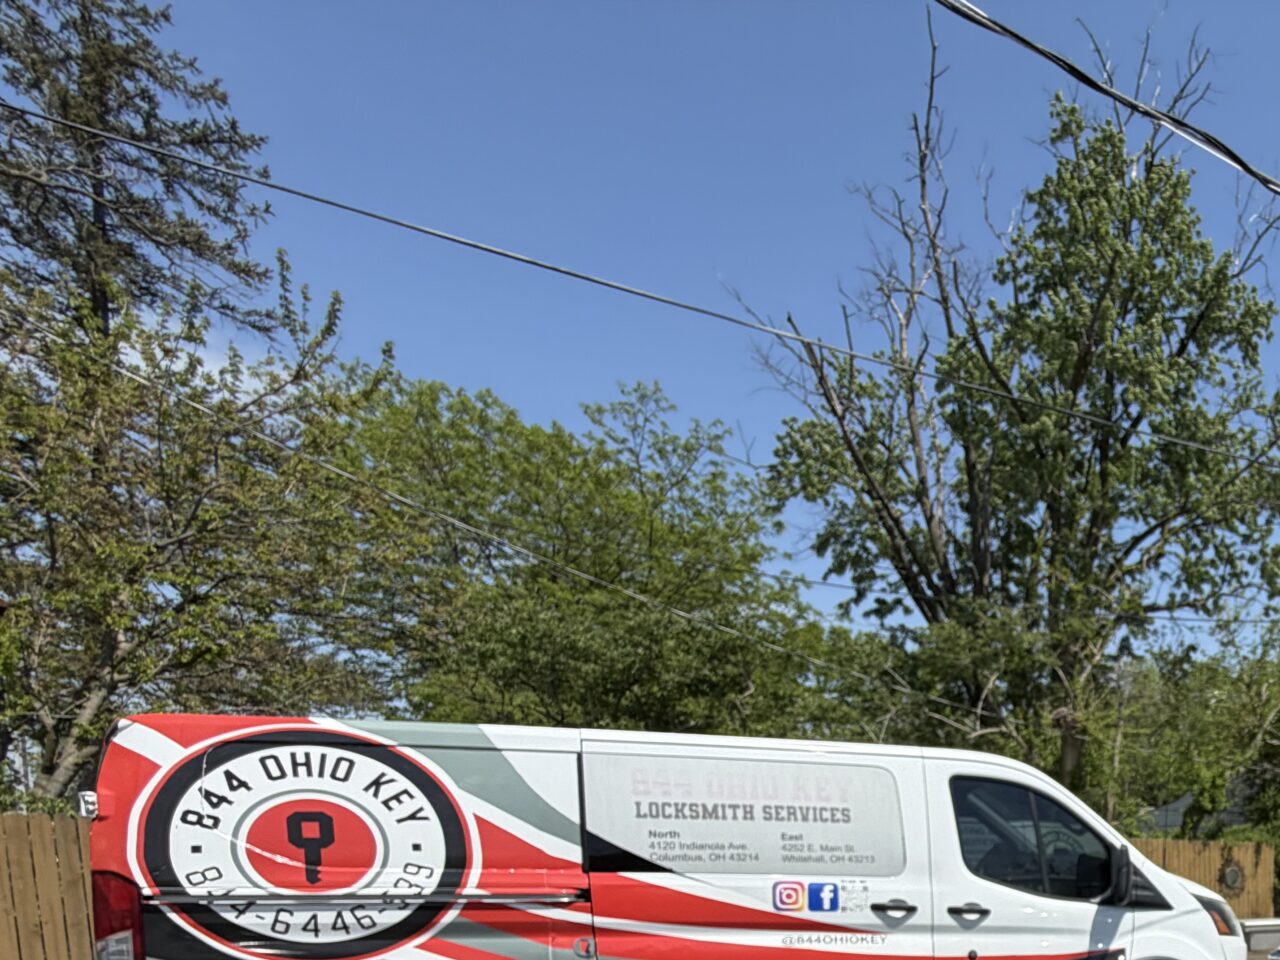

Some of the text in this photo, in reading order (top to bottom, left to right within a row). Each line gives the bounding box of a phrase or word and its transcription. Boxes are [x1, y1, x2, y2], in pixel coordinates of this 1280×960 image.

[180, 752, 431, 830] 844 OHIO KEY
[635, 801, 852, 824] LOCKSMITH SERVICES
[648, 829, 680, 839] North
[781, 832, 804, 842] East
[648, 841, 676, 851] 4120
[678, 841, 726, 851] Indianola
[820, 844, 843, 853] Main
[649, 852, 760, 863] Columbus, OH 43214
[830, 855, 848, 864] OH
